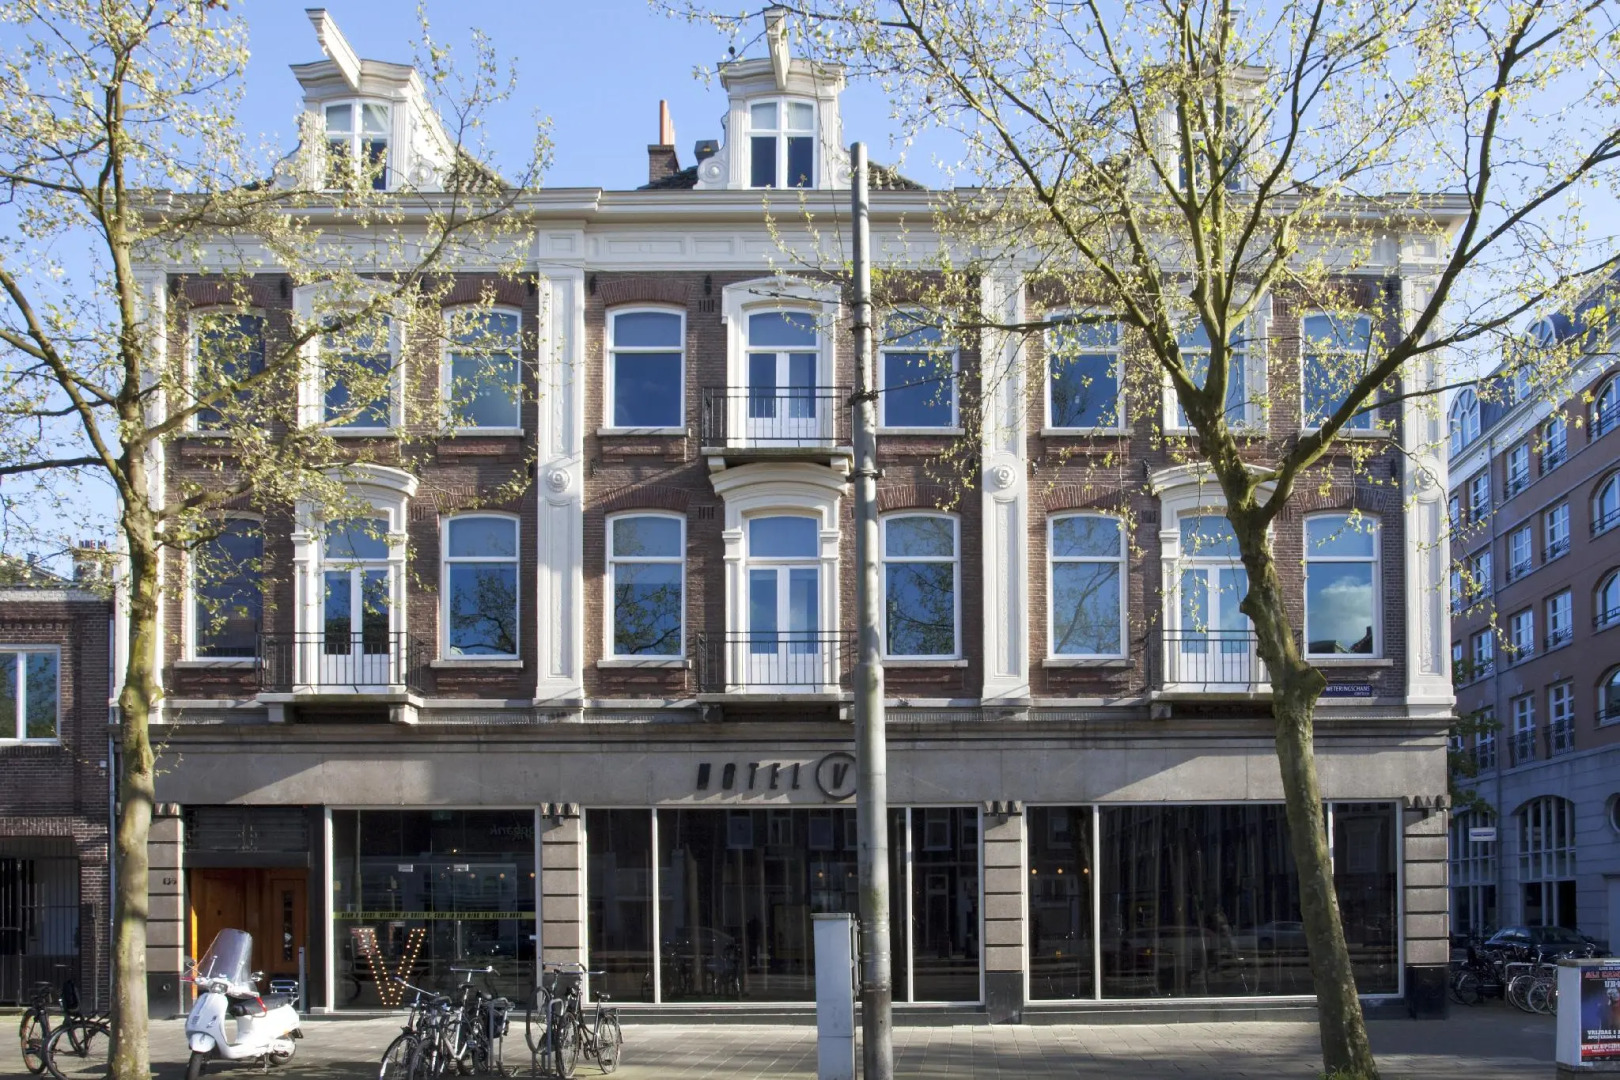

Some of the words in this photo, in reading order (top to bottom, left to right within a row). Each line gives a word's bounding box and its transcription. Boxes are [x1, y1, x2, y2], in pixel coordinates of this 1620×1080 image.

[696, 762, 800, 790] HOTEL
[833, 763, 849, 789] V
[356, 927, 427, 1006] V
